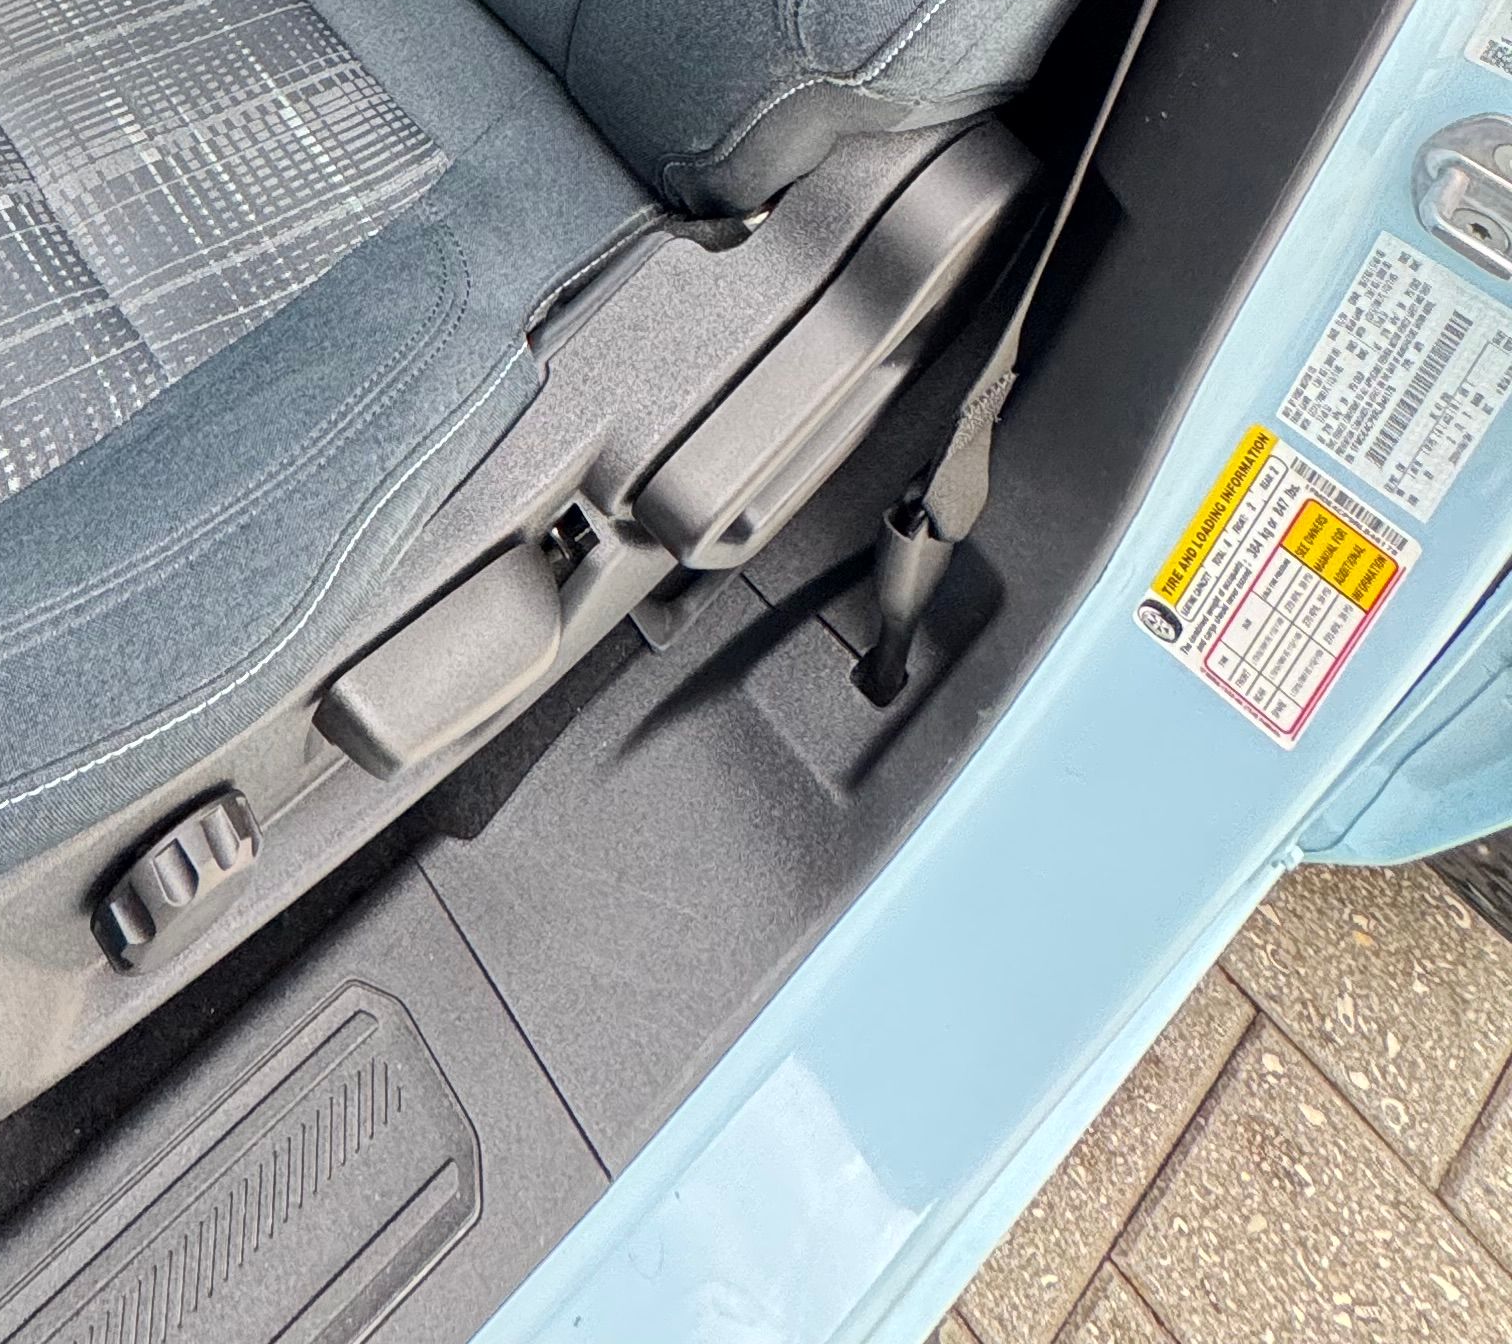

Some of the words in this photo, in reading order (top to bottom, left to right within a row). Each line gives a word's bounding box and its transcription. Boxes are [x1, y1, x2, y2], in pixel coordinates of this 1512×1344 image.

[1162, 569, 1184, 597] TIRE
[1176, 545, 1198, 572] AND
[1191, 500, 1226, 549] LOADING
[1219, 431, 1269, 503] INFORMATION
[1245, 500, 1256, 511] 2
[1245, 538, 1263, 558] 384
[1258, 525, 1274, 542] kg
[1266, 517, 1278, 529] or
[1272, 496, 1290, 517] 847
[1294, 541, 1310, 558] SEE
[1302, 512, 1328, 546] OWNERS
[1312, 541, 1338, 573] MANUAL
[1331, 526, 1347, 544] FOR
[1333, 542, 1365, 586] ADDITIONAL
[1351, 553, 1387, 602] INFORMATION
